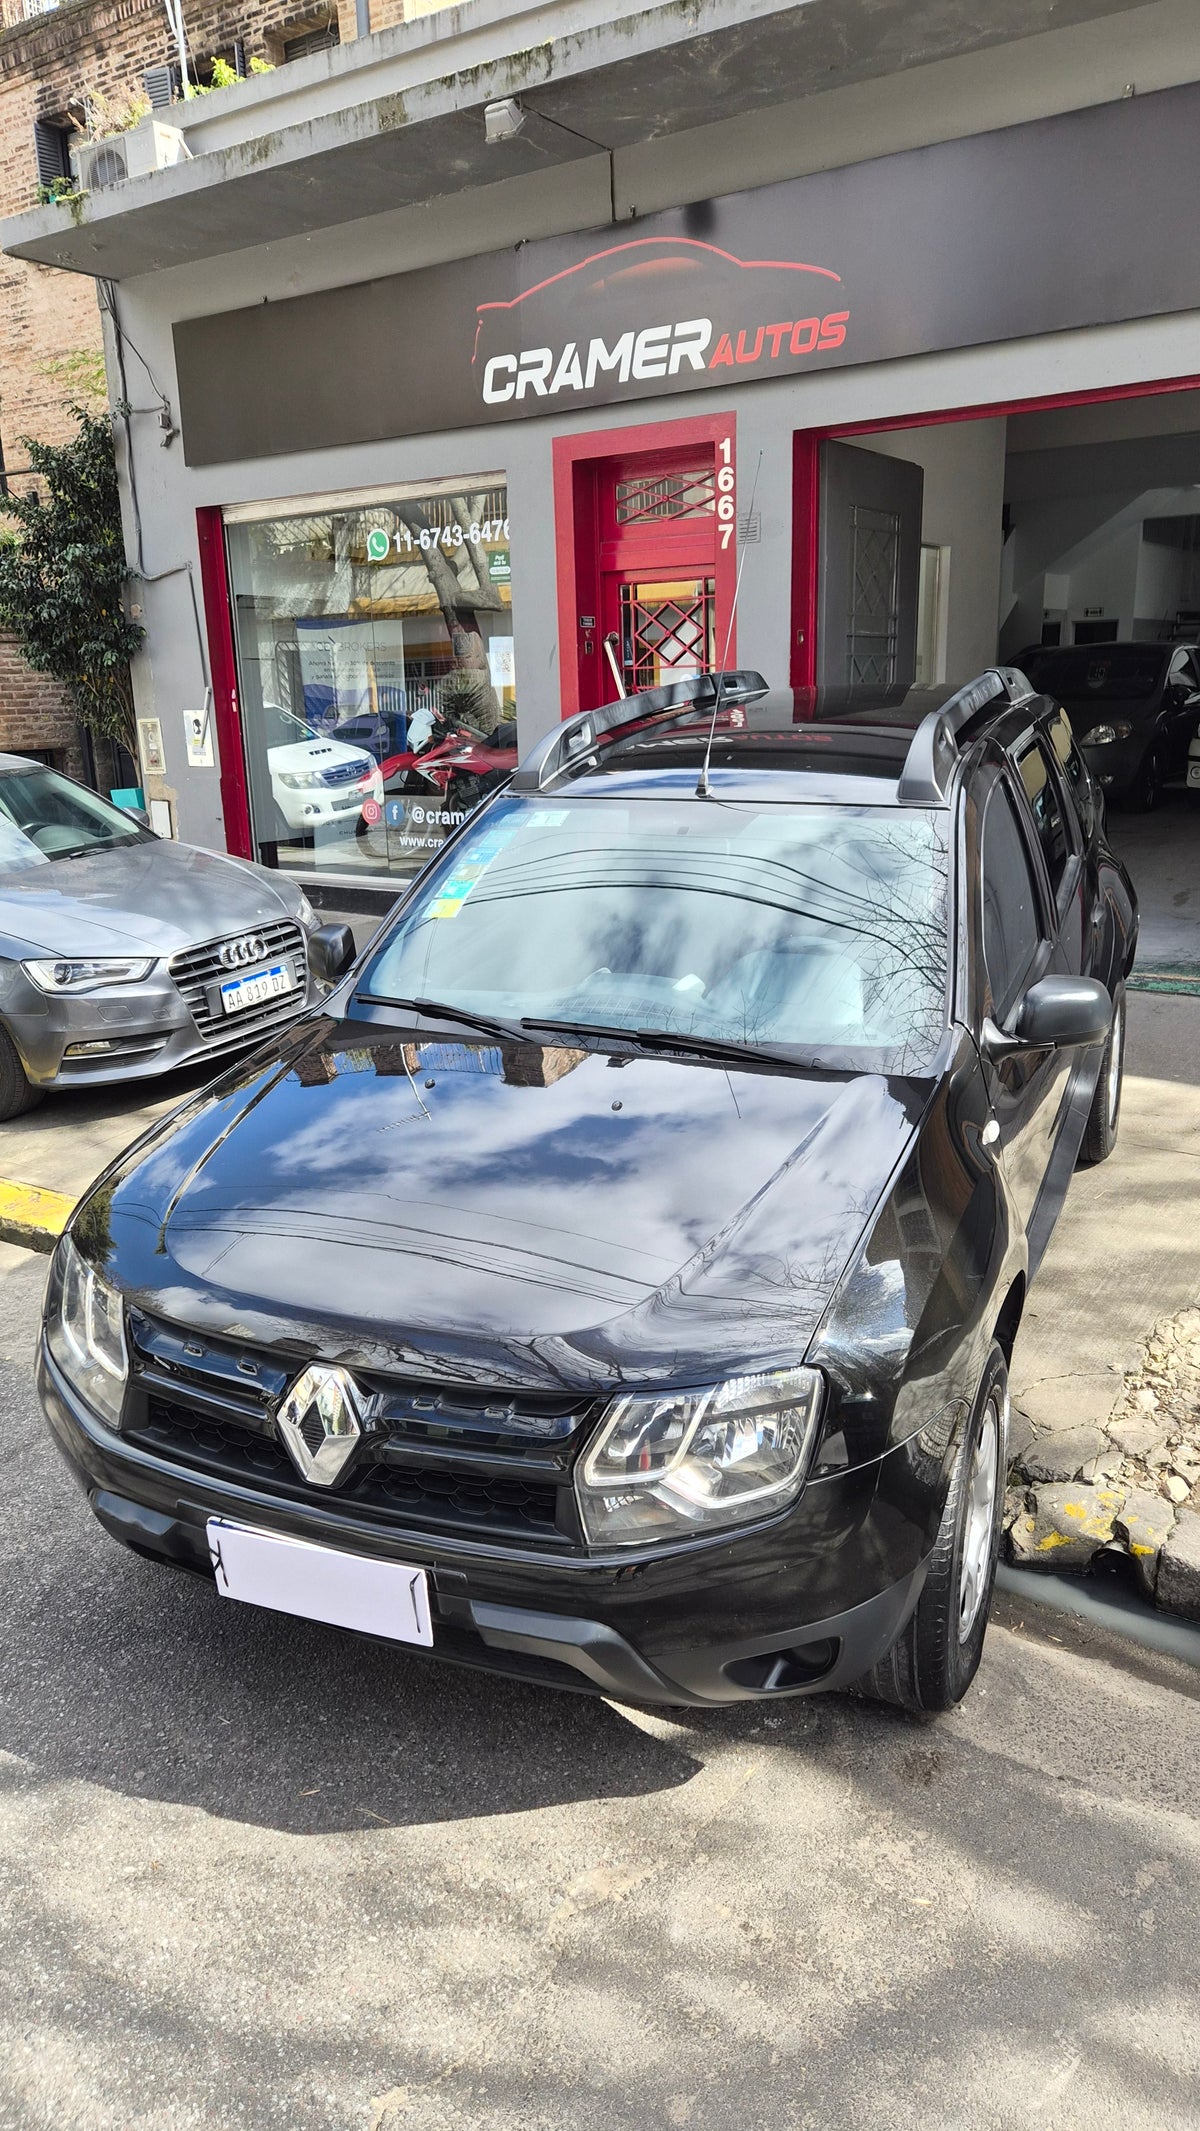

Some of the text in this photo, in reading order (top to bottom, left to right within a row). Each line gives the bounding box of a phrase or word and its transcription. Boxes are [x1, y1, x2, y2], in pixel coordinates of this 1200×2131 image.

[482, 311, 850, 404] CRAMER AUTOS
[718, 437, 735, 550] 1667
[412, 806, 469, 825] @cram
[228, 990, 243, 1009] AA
[246, 981, 268, 1001] 819
